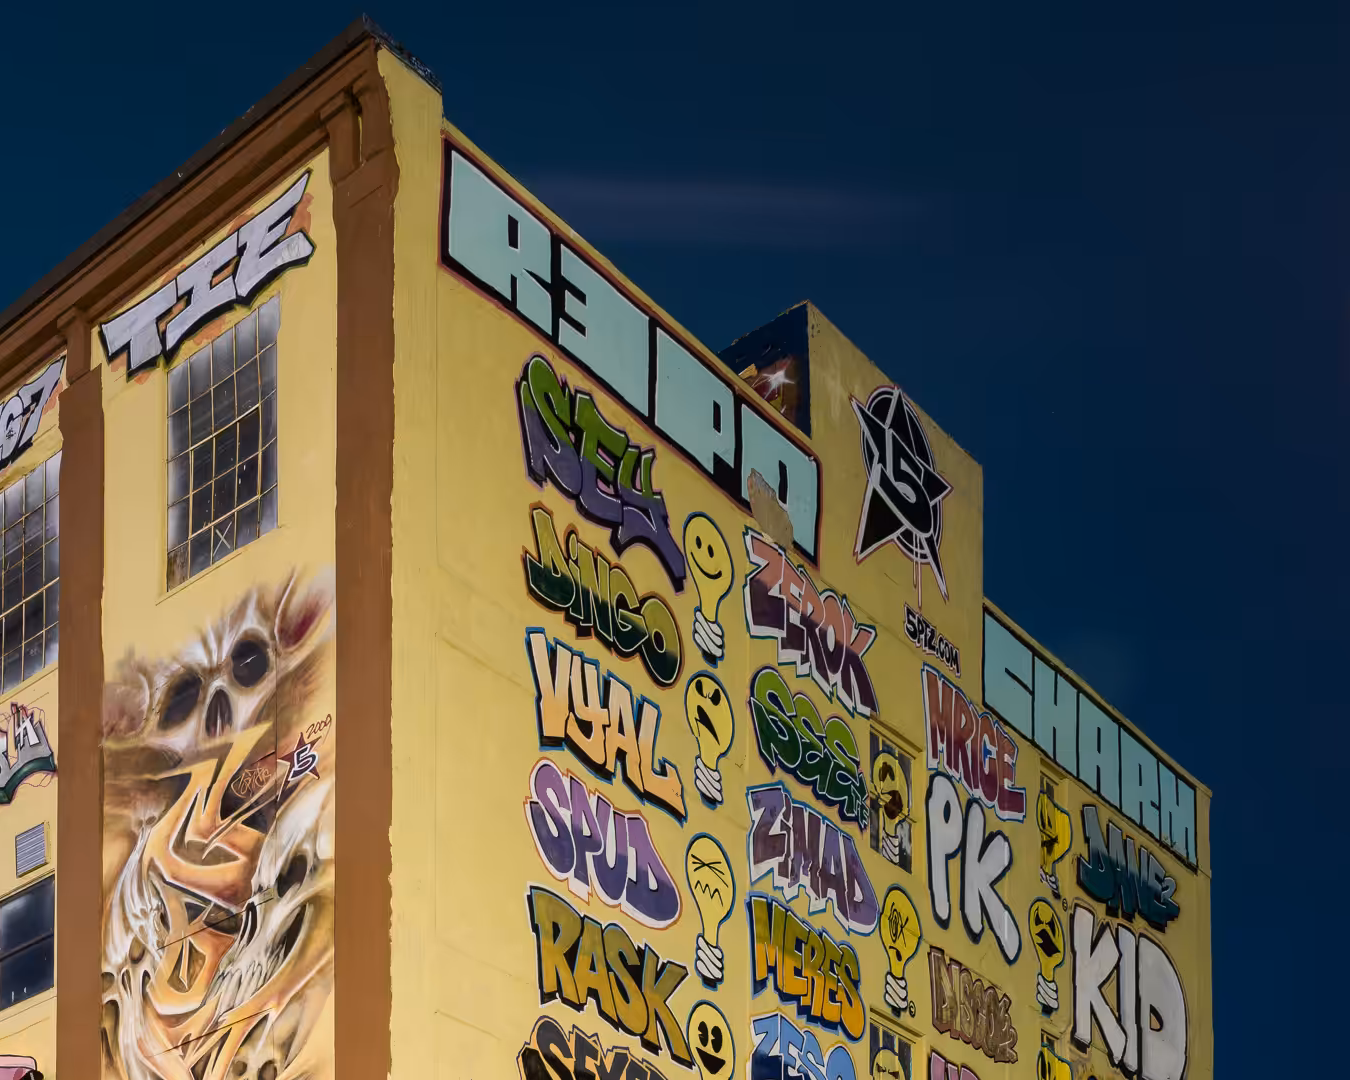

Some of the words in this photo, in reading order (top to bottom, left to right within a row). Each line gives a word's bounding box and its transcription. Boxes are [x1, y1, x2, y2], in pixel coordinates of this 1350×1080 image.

[903, 603, 962, 678] 5PTZ.COM
[525, 757, 683, 930] SPUD
[926, 770, 1023, 966] PK
[526, 882, 695, 1071] RASK
[745, 890, 866, 1044] MERES
